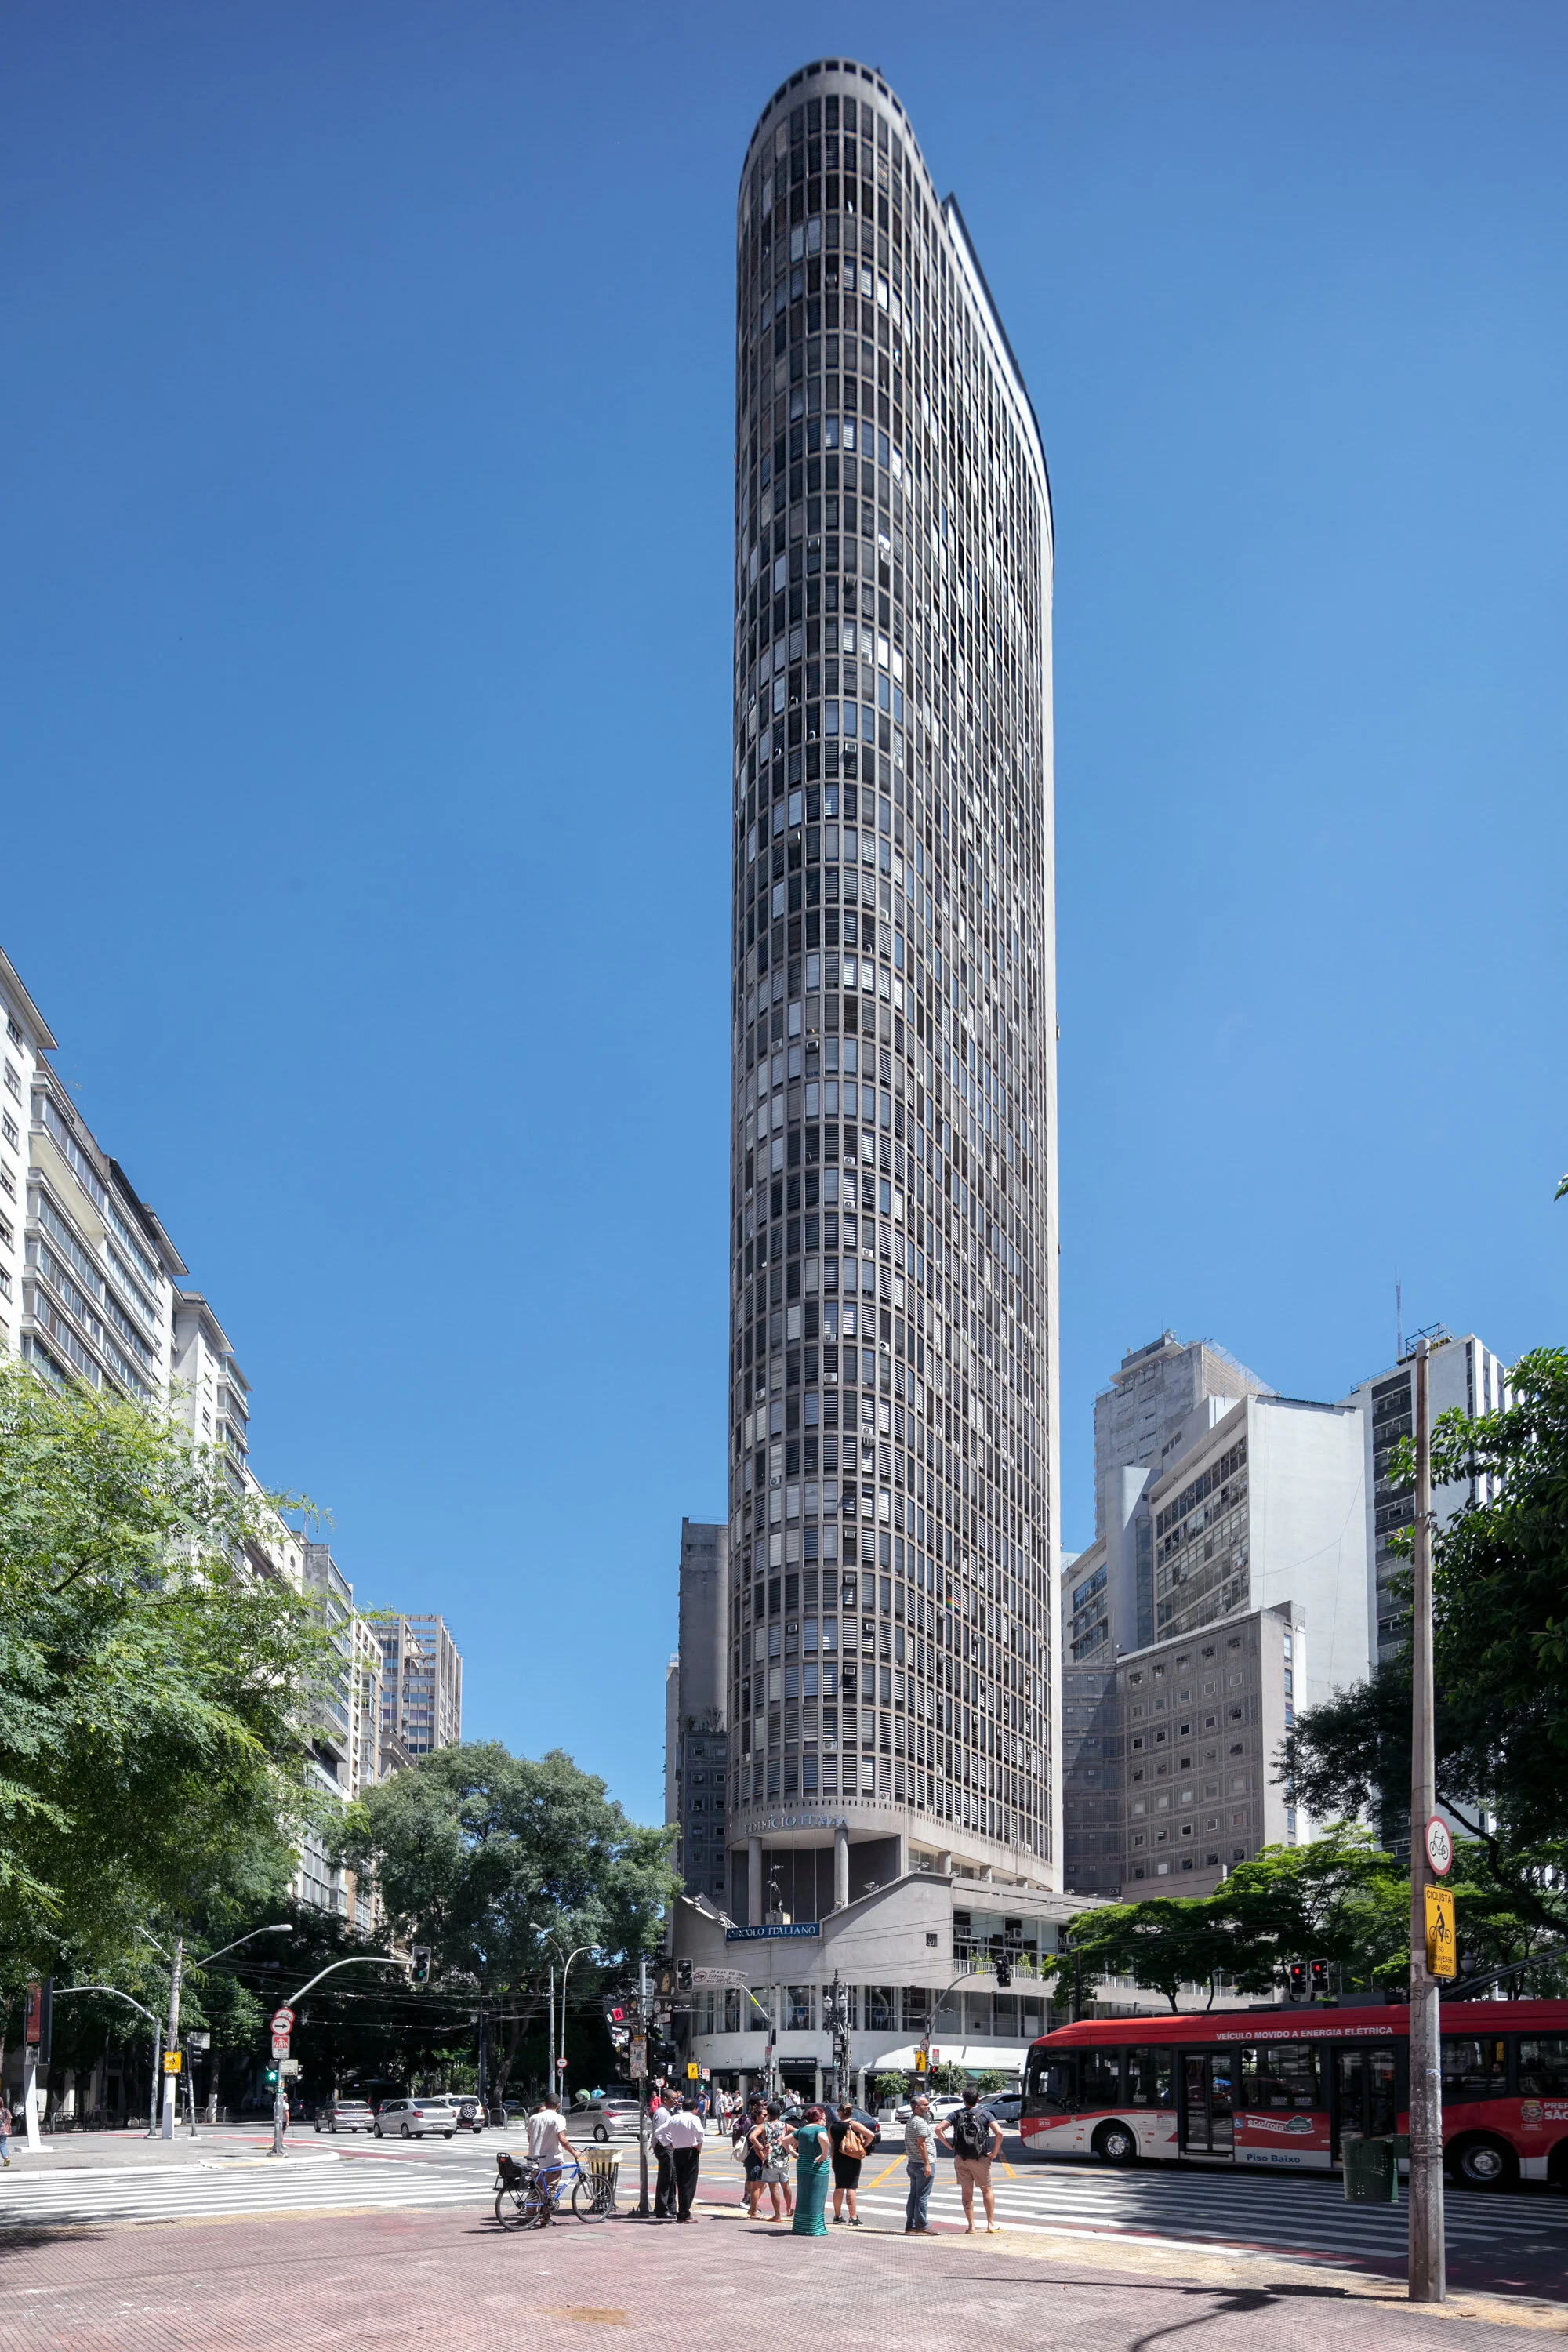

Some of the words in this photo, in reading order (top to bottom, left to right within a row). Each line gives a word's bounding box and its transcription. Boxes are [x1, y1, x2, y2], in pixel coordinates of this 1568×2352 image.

[744, 1814, 797, 1834] EDIFÍCIO
[800, 1812, 850, 1825] ITÁLIA
[1427, 1890, 1452, 1904] CICLISTA
[728, 1928, 765, 1939] CIRCOLO
[768, 1926, 816, 1936] ITALIANO
[1430, 1954, 1453, 1964] ATRAVESSE
[1439, 1964, 1452, 1973] VERDE
[1216, 2031, 1253, 2040] VEÍCULO
[1254, 2031, 1290, 2039] MOVIDO
[1301, 2028, 1342, 2037] ENERGIA
[1345, 2026, 1393, 2035] ELÉTRICA
[1247, 2119, 1284, 2132] ecofrota
[1247, 2154, 1268, 2162] Piso
[1271, 2154, 1301, 2163] Baixo
